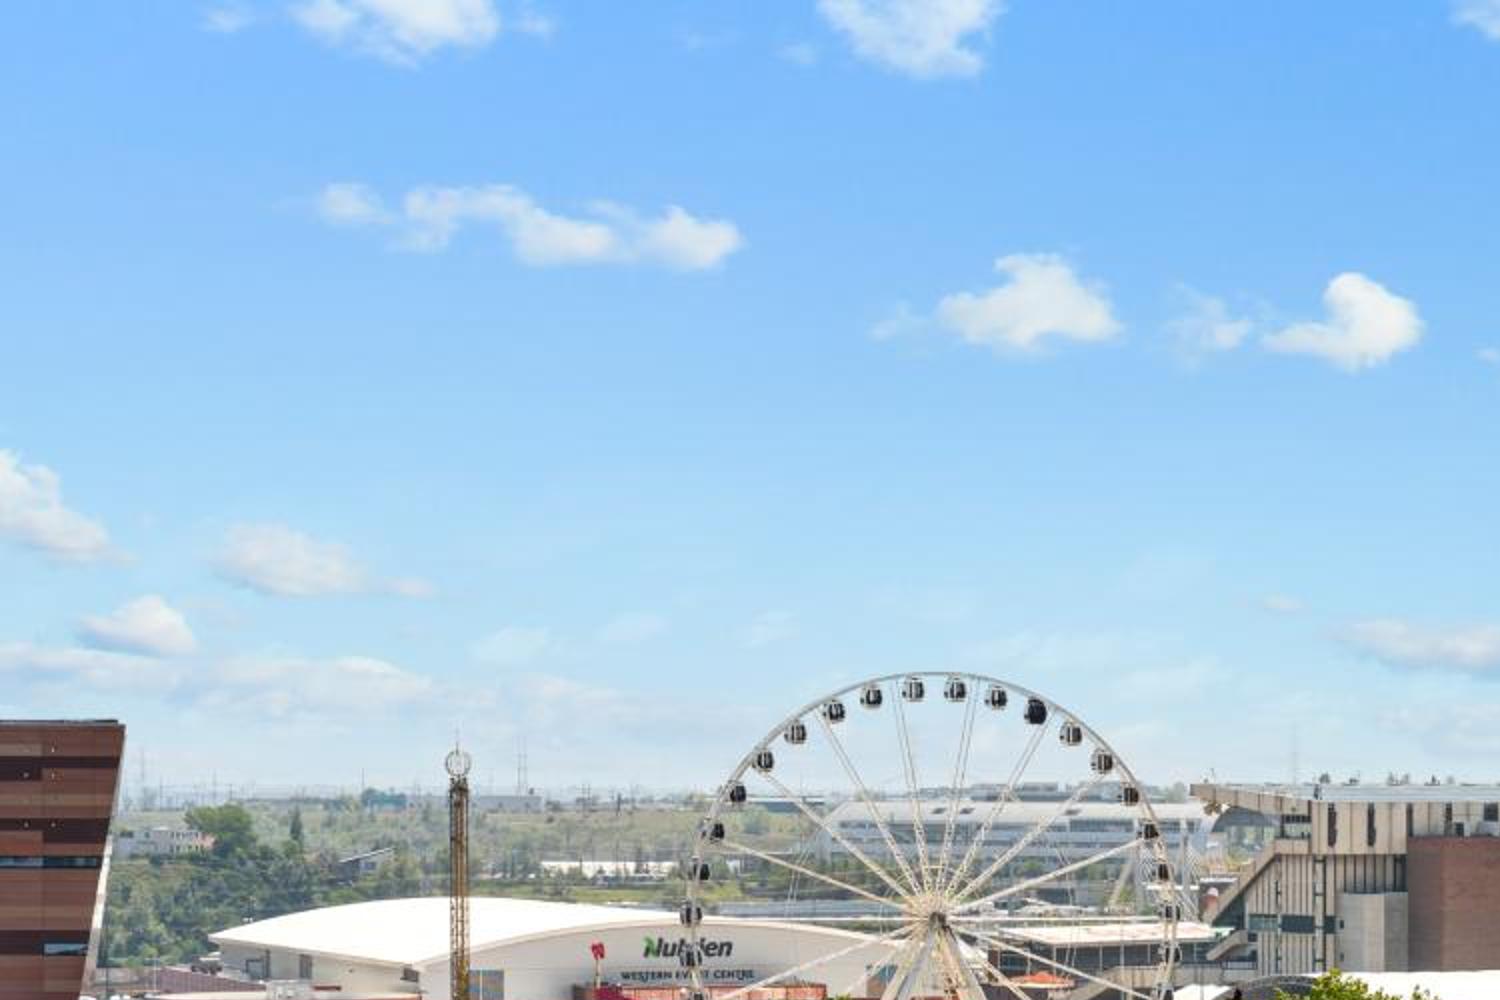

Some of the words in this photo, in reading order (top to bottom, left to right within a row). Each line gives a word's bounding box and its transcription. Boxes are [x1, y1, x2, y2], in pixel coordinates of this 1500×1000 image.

[643, 937, 733, 958] Nutien
[620, 969, 672, 982] WESTERN
[713, 969, 755, 981] CENTRE
